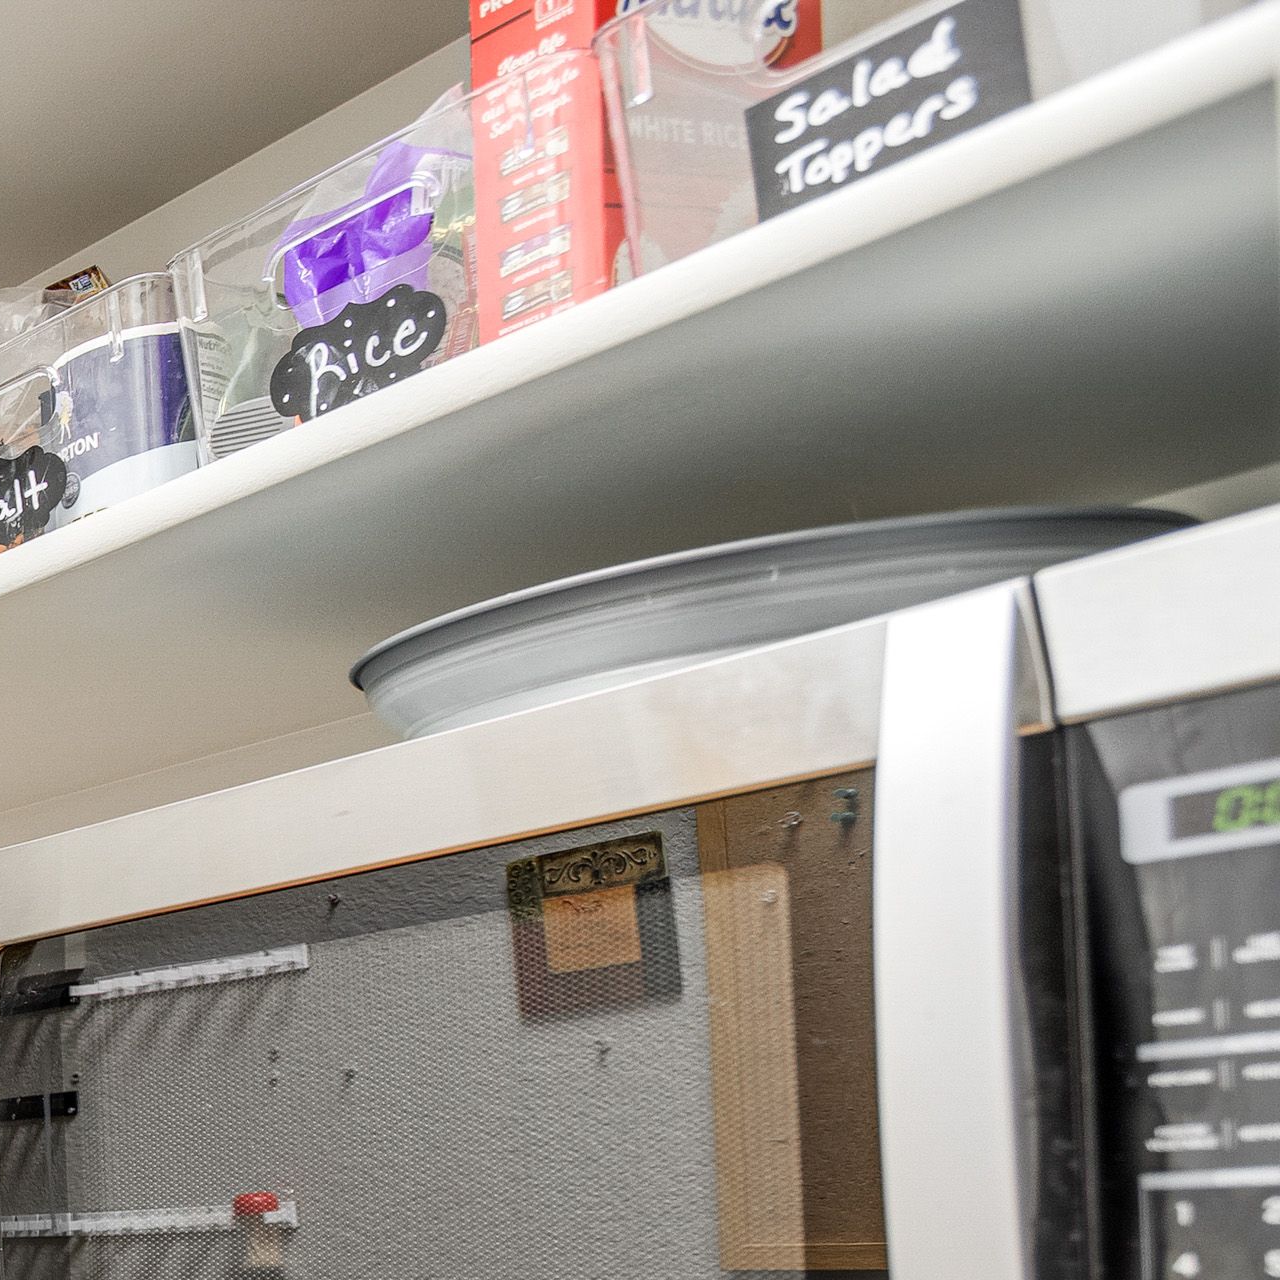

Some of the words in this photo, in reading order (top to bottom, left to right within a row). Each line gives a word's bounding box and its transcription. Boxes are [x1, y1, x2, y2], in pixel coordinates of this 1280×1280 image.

[774, 16, 962, 144] Salad
[774, 75, 978, 193] Toppers
[308, 318, 428, 419] Rice
[57, 432, 101, 464] RTON
